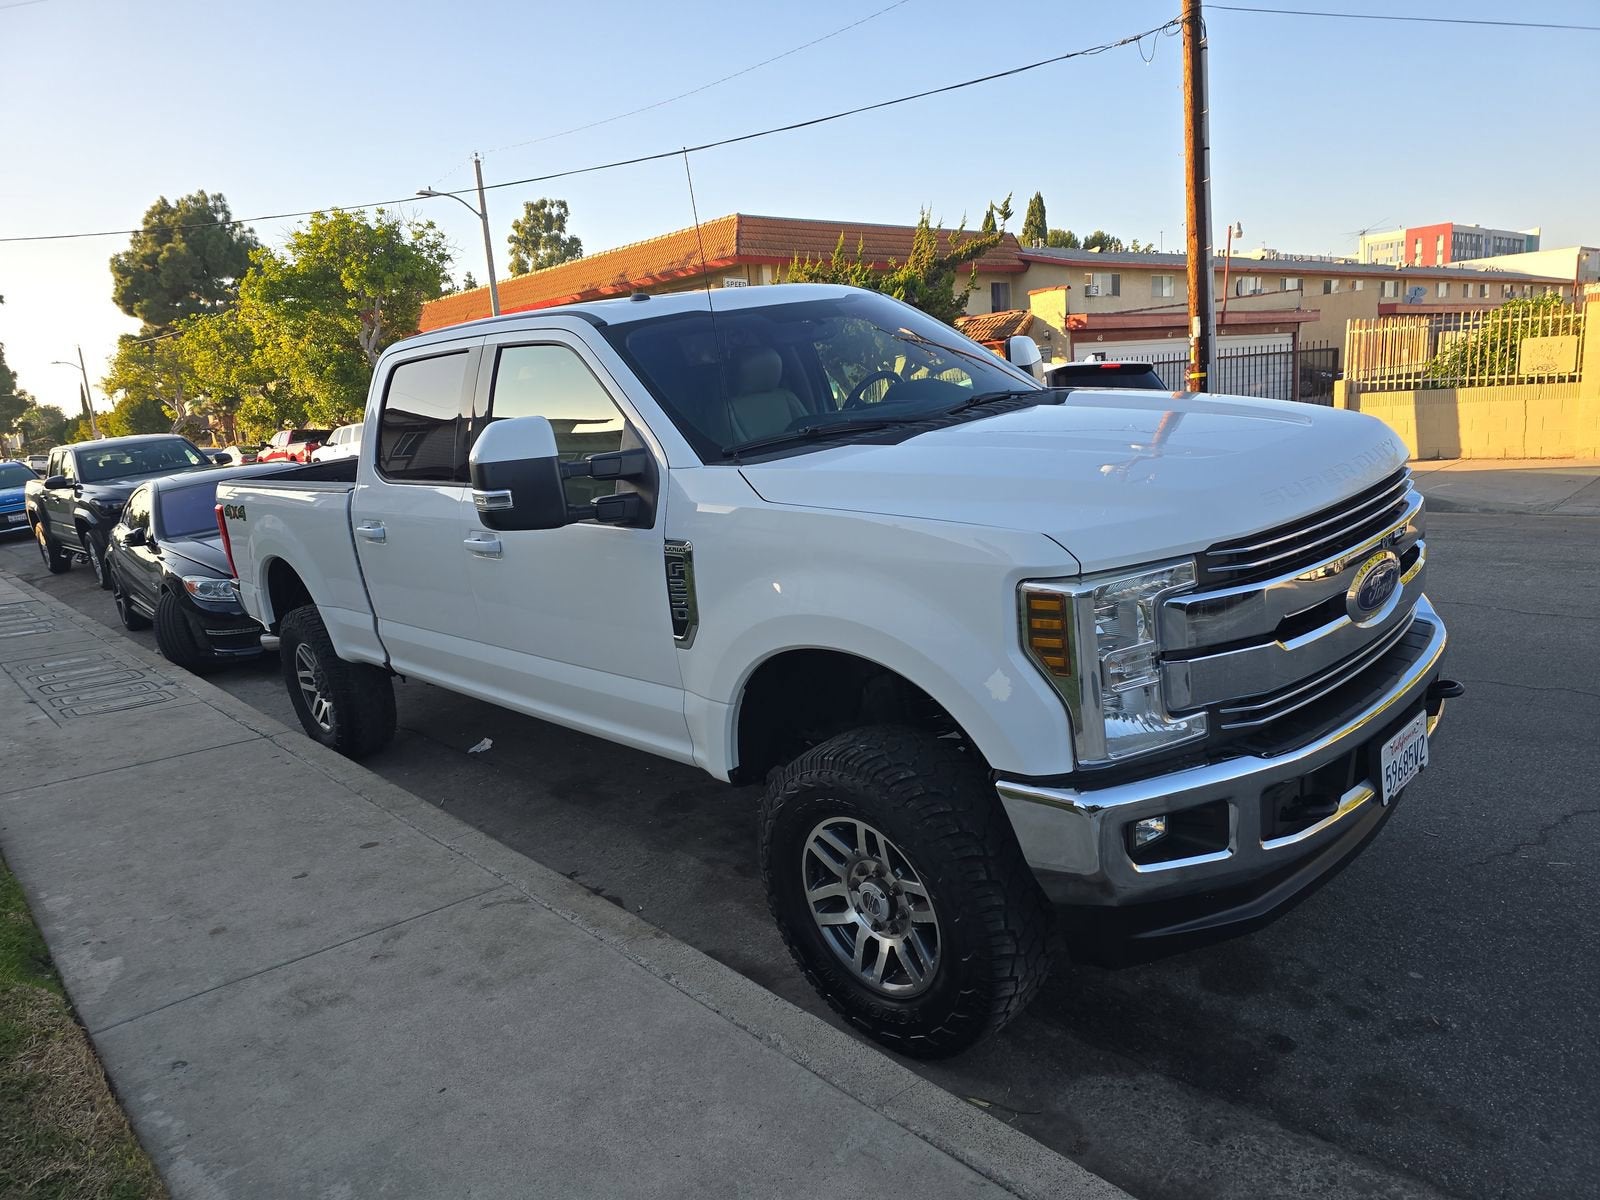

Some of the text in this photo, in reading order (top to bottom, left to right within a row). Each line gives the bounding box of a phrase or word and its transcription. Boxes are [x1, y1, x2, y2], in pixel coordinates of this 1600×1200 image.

[726, 280, 747, 288] SPEED
[1260, 438, 1398, 506] SUPER DUTY
[1385, 735, 1425, 793] 59685V2
